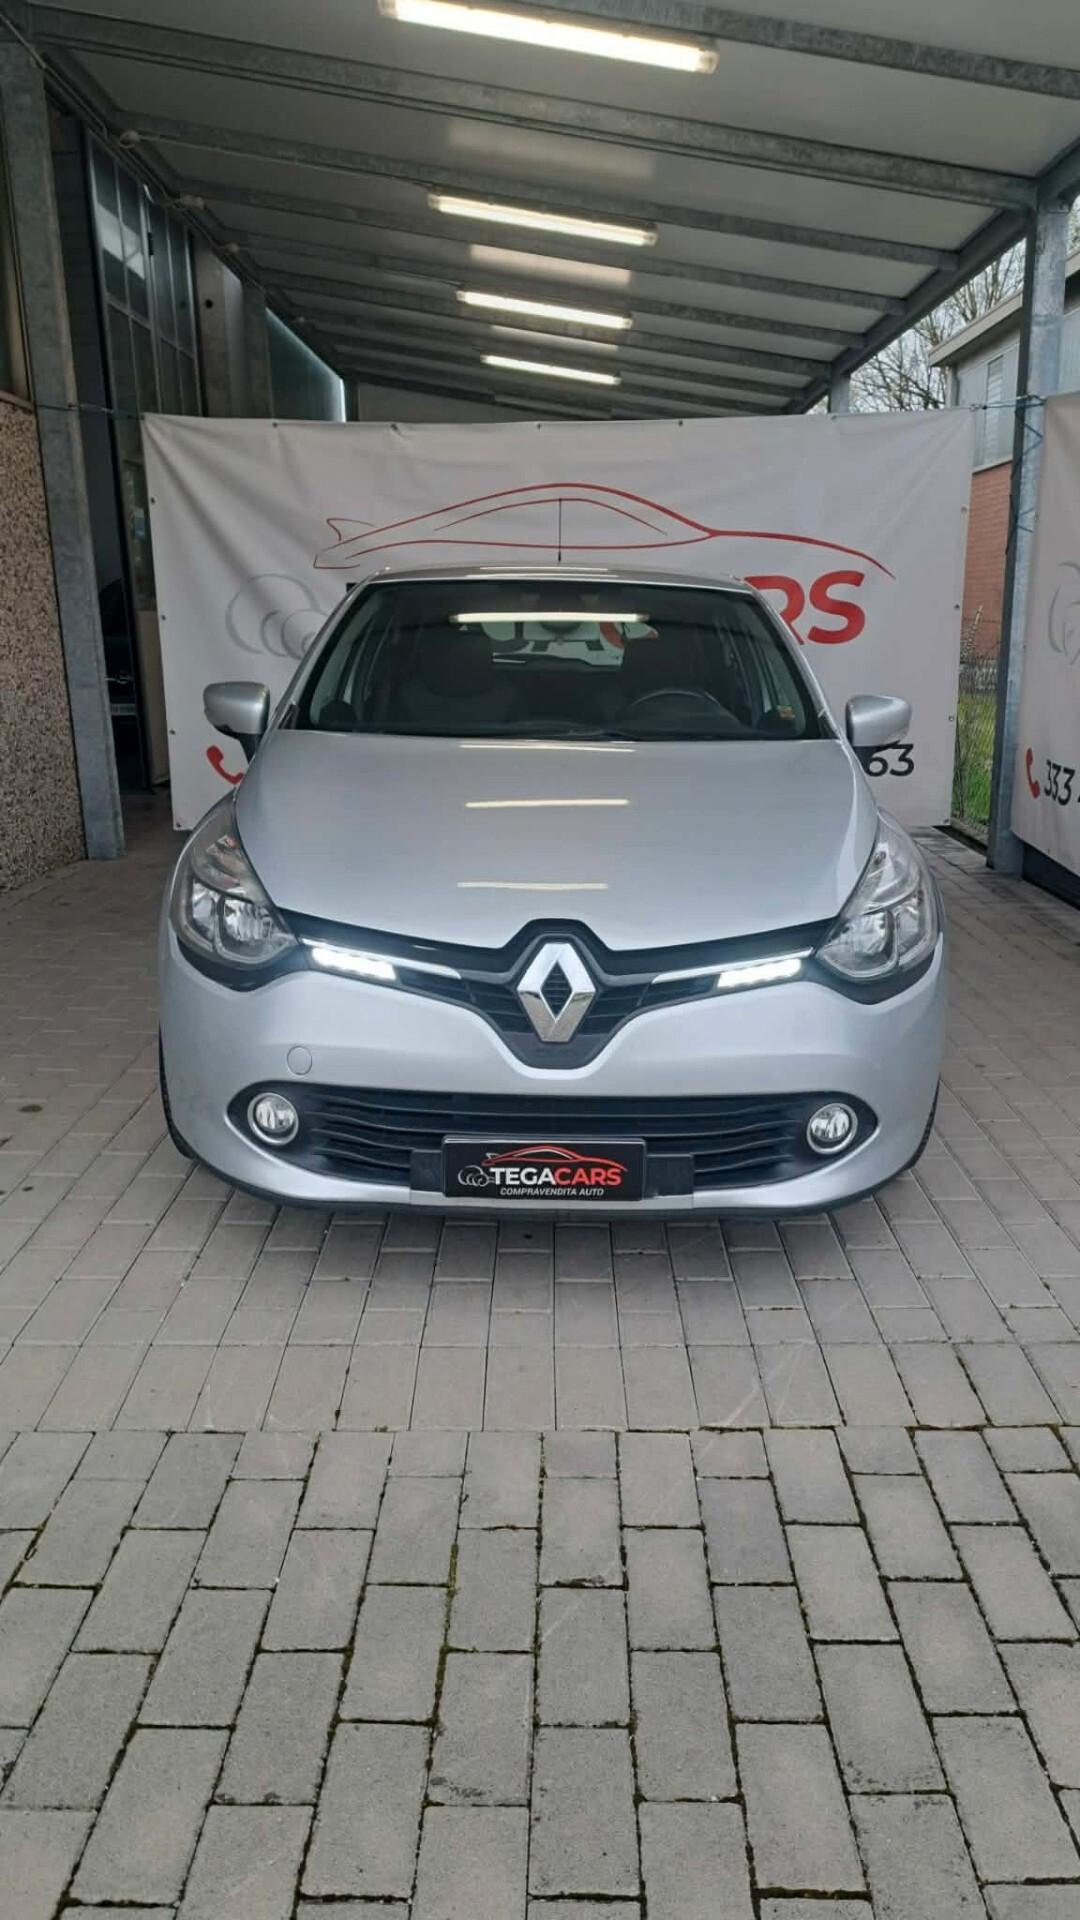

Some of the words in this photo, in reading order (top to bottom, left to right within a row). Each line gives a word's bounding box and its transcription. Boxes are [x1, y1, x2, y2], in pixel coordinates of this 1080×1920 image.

[490, 1167, 622, 1186] TEGACARS
[500, 1187, 577, 1196] COMPRAVENDITA
[578, 1188, 605, 1196] AUTO
